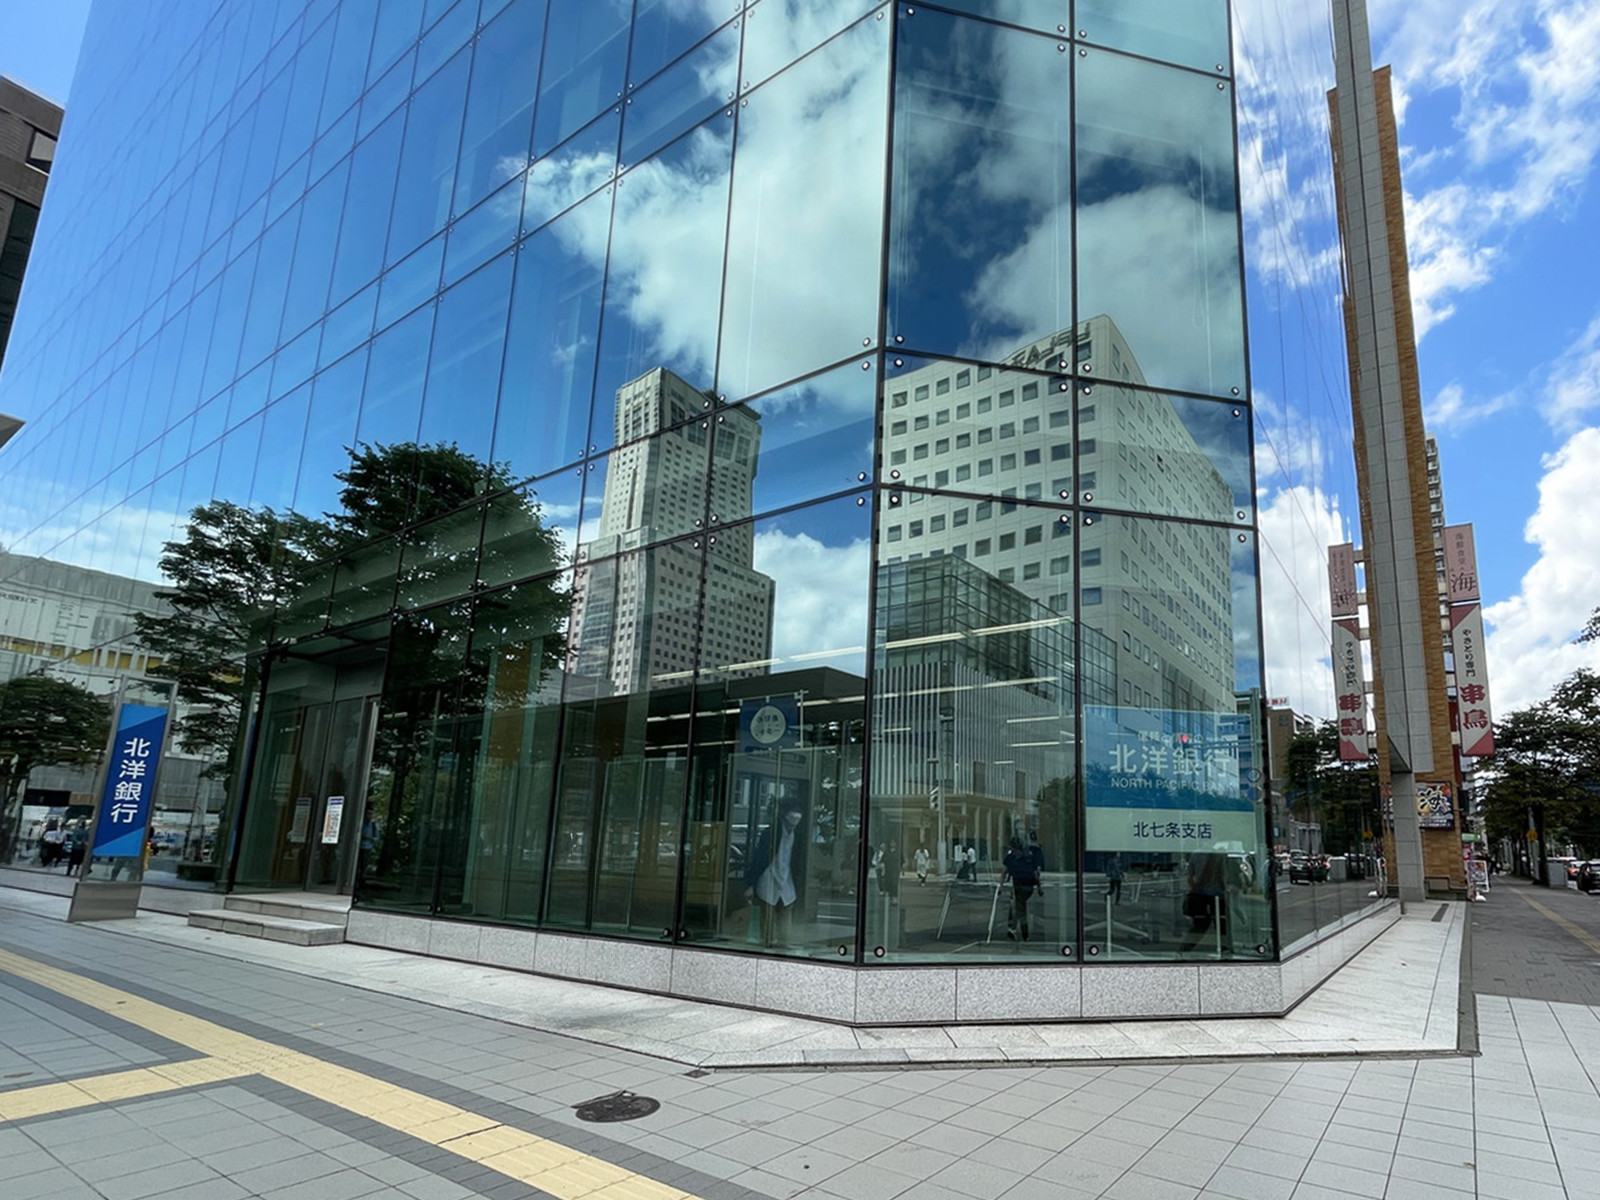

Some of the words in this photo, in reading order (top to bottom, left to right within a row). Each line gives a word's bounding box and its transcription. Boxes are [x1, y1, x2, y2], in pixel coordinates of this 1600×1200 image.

[1460, 683, 1488, 729] 串鳥
[1108, 743, 1231, 778] 北洋銀行
[110, 737, 151, 825] 北洋銀行
[1111, 778, 1152, 789] NORTH
[1156, 779, 1199, 791] PACIFIC
[1133, 821, 1212, 839] 北七条支店
